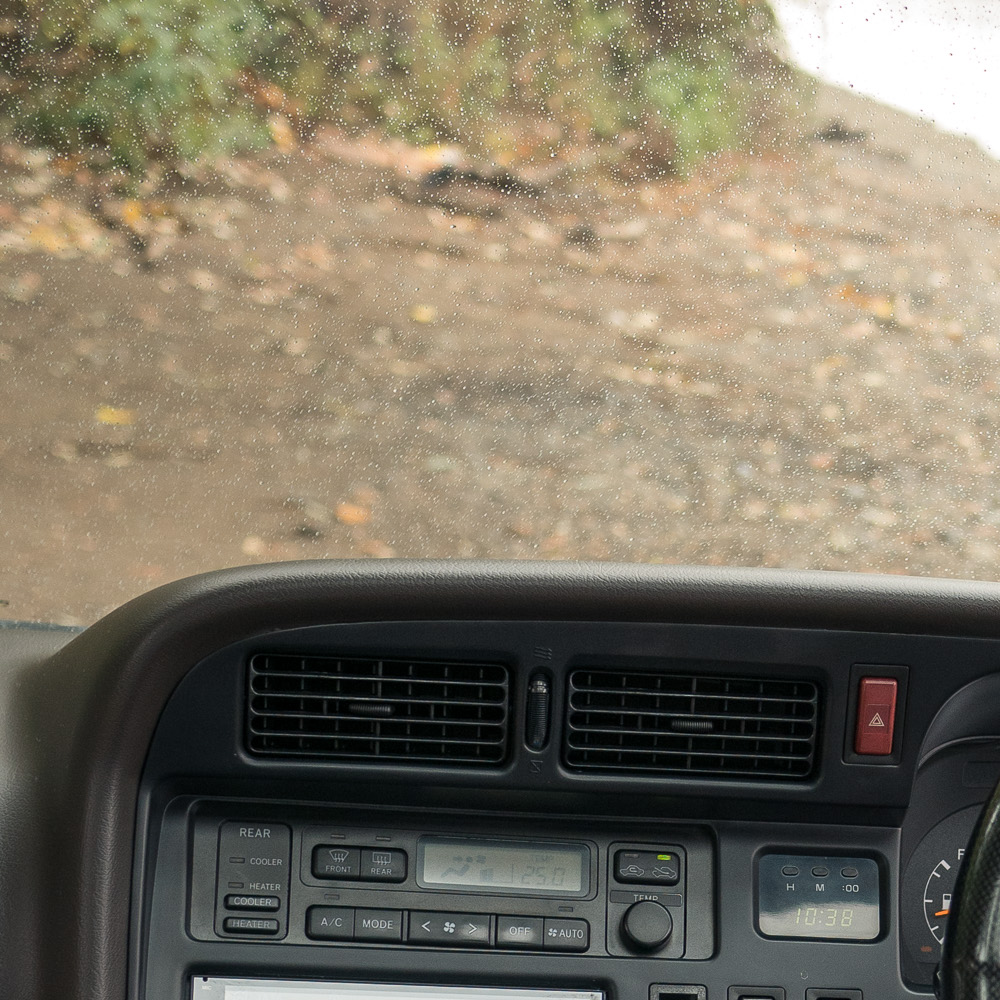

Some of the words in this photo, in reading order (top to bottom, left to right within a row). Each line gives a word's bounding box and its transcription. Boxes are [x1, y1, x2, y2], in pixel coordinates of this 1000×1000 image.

[239, 828, 271, 838] REAR
[957, 848, 966, 861] F
[250, 857, 283, 866] COOLER
[325, 865, 351, 873] FRONT
[370, 867, 392, 875] REAR
[250, 882, 281, 891] HEATER
[786, 883, 795, 891] H
[815, 883, 825, 892] M
[233, 897, 272, 906] COOLER
[320, 917, 343, 927] A/C
[796, 908, 853, 927] 10:38
[232, 919, 271, 929] HEATER
[362, 919, 394, 929] MODE
[509, 926, 531, 936] OFF
[559, 929, 584, 939] AUTO
